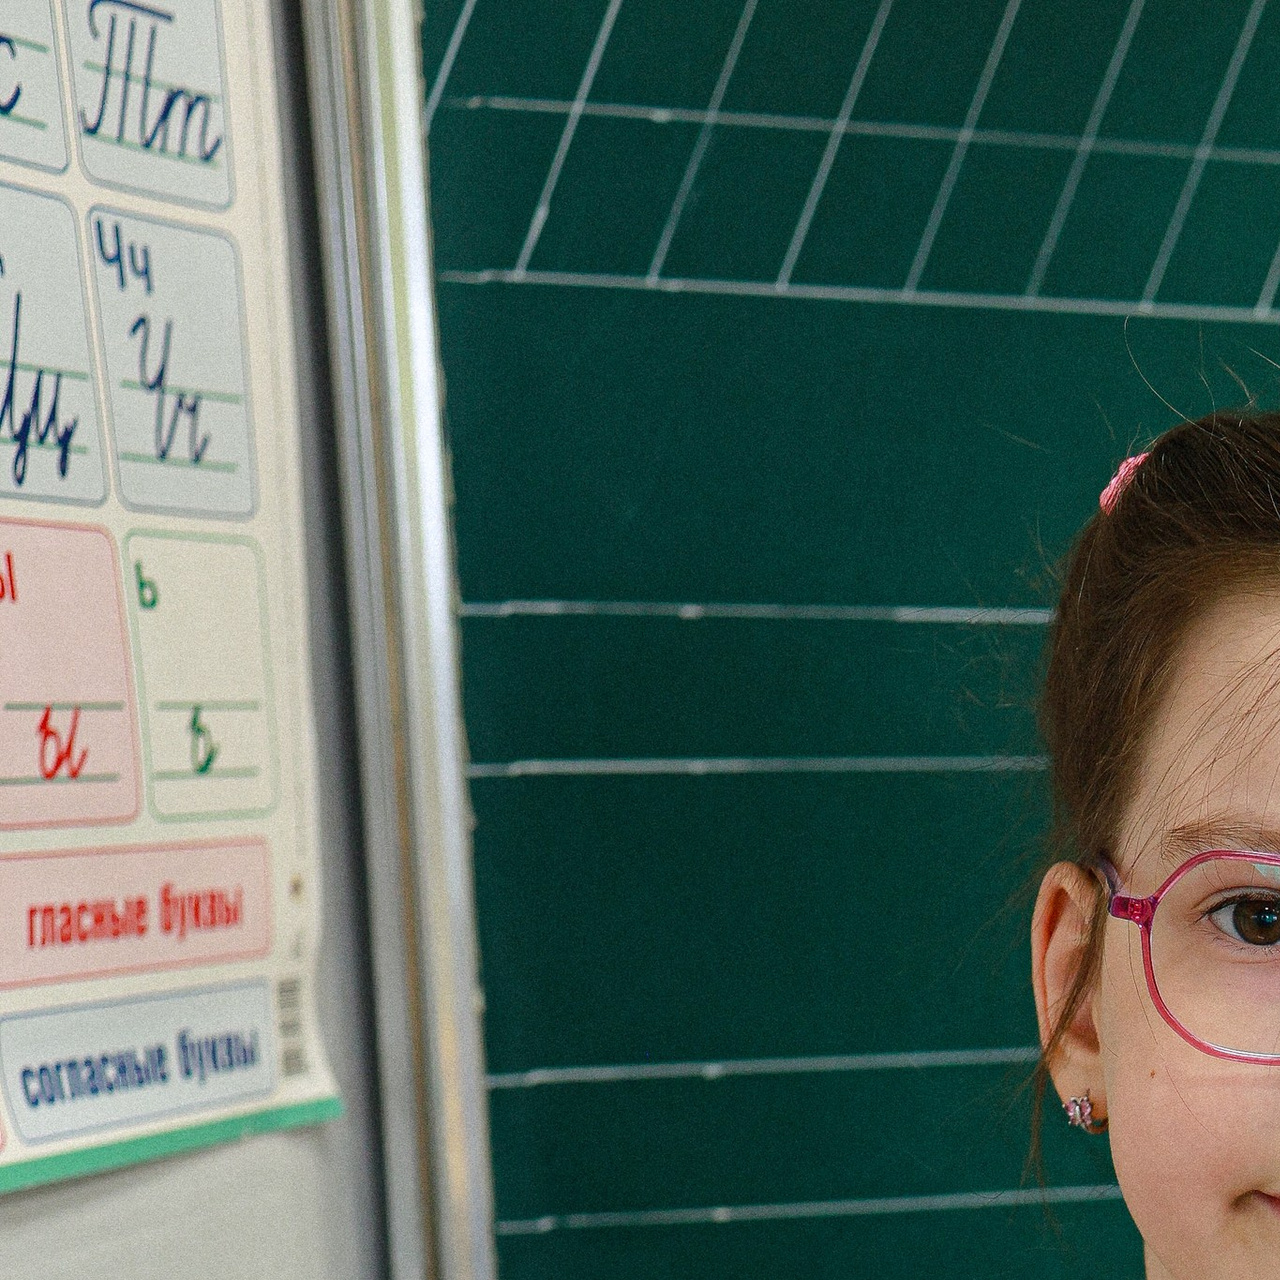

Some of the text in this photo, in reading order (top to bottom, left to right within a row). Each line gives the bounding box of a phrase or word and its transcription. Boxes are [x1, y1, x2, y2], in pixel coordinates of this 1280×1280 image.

[28, 881, 243, 948] гласные буквы
[21, 1027, 259, 1108] согласные буквы
